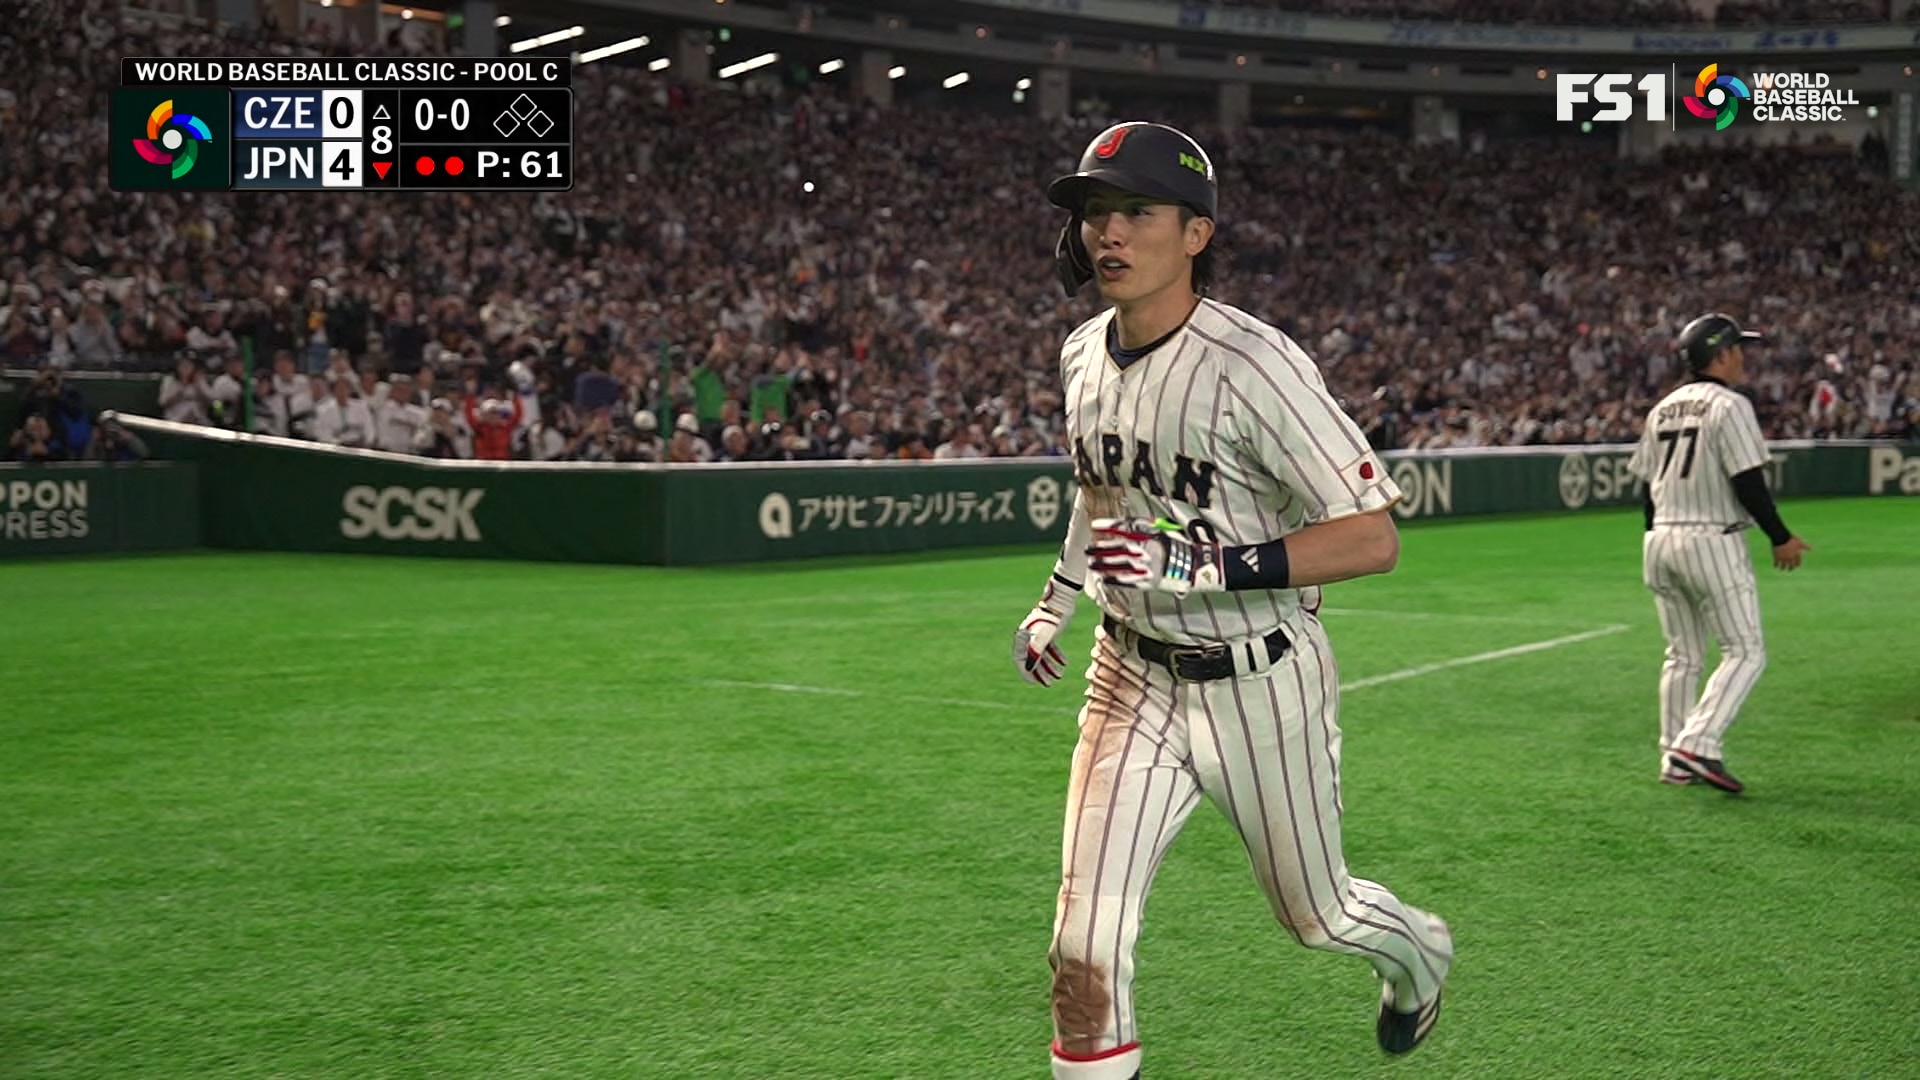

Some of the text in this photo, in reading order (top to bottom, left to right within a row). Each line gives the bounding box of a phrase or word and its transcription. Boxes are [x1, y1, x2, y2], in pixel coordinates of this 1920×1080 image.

[1075, 433, 1217, 508] APAN
[1657, 426, 1700, 480] 77
[341, 487, 484, 541] SCSK
[798, 489, 1015, 530] アサヒファシリティズ
[1390, 458, 1453, 518] ON
[0, 508, 89, 540] RESS
